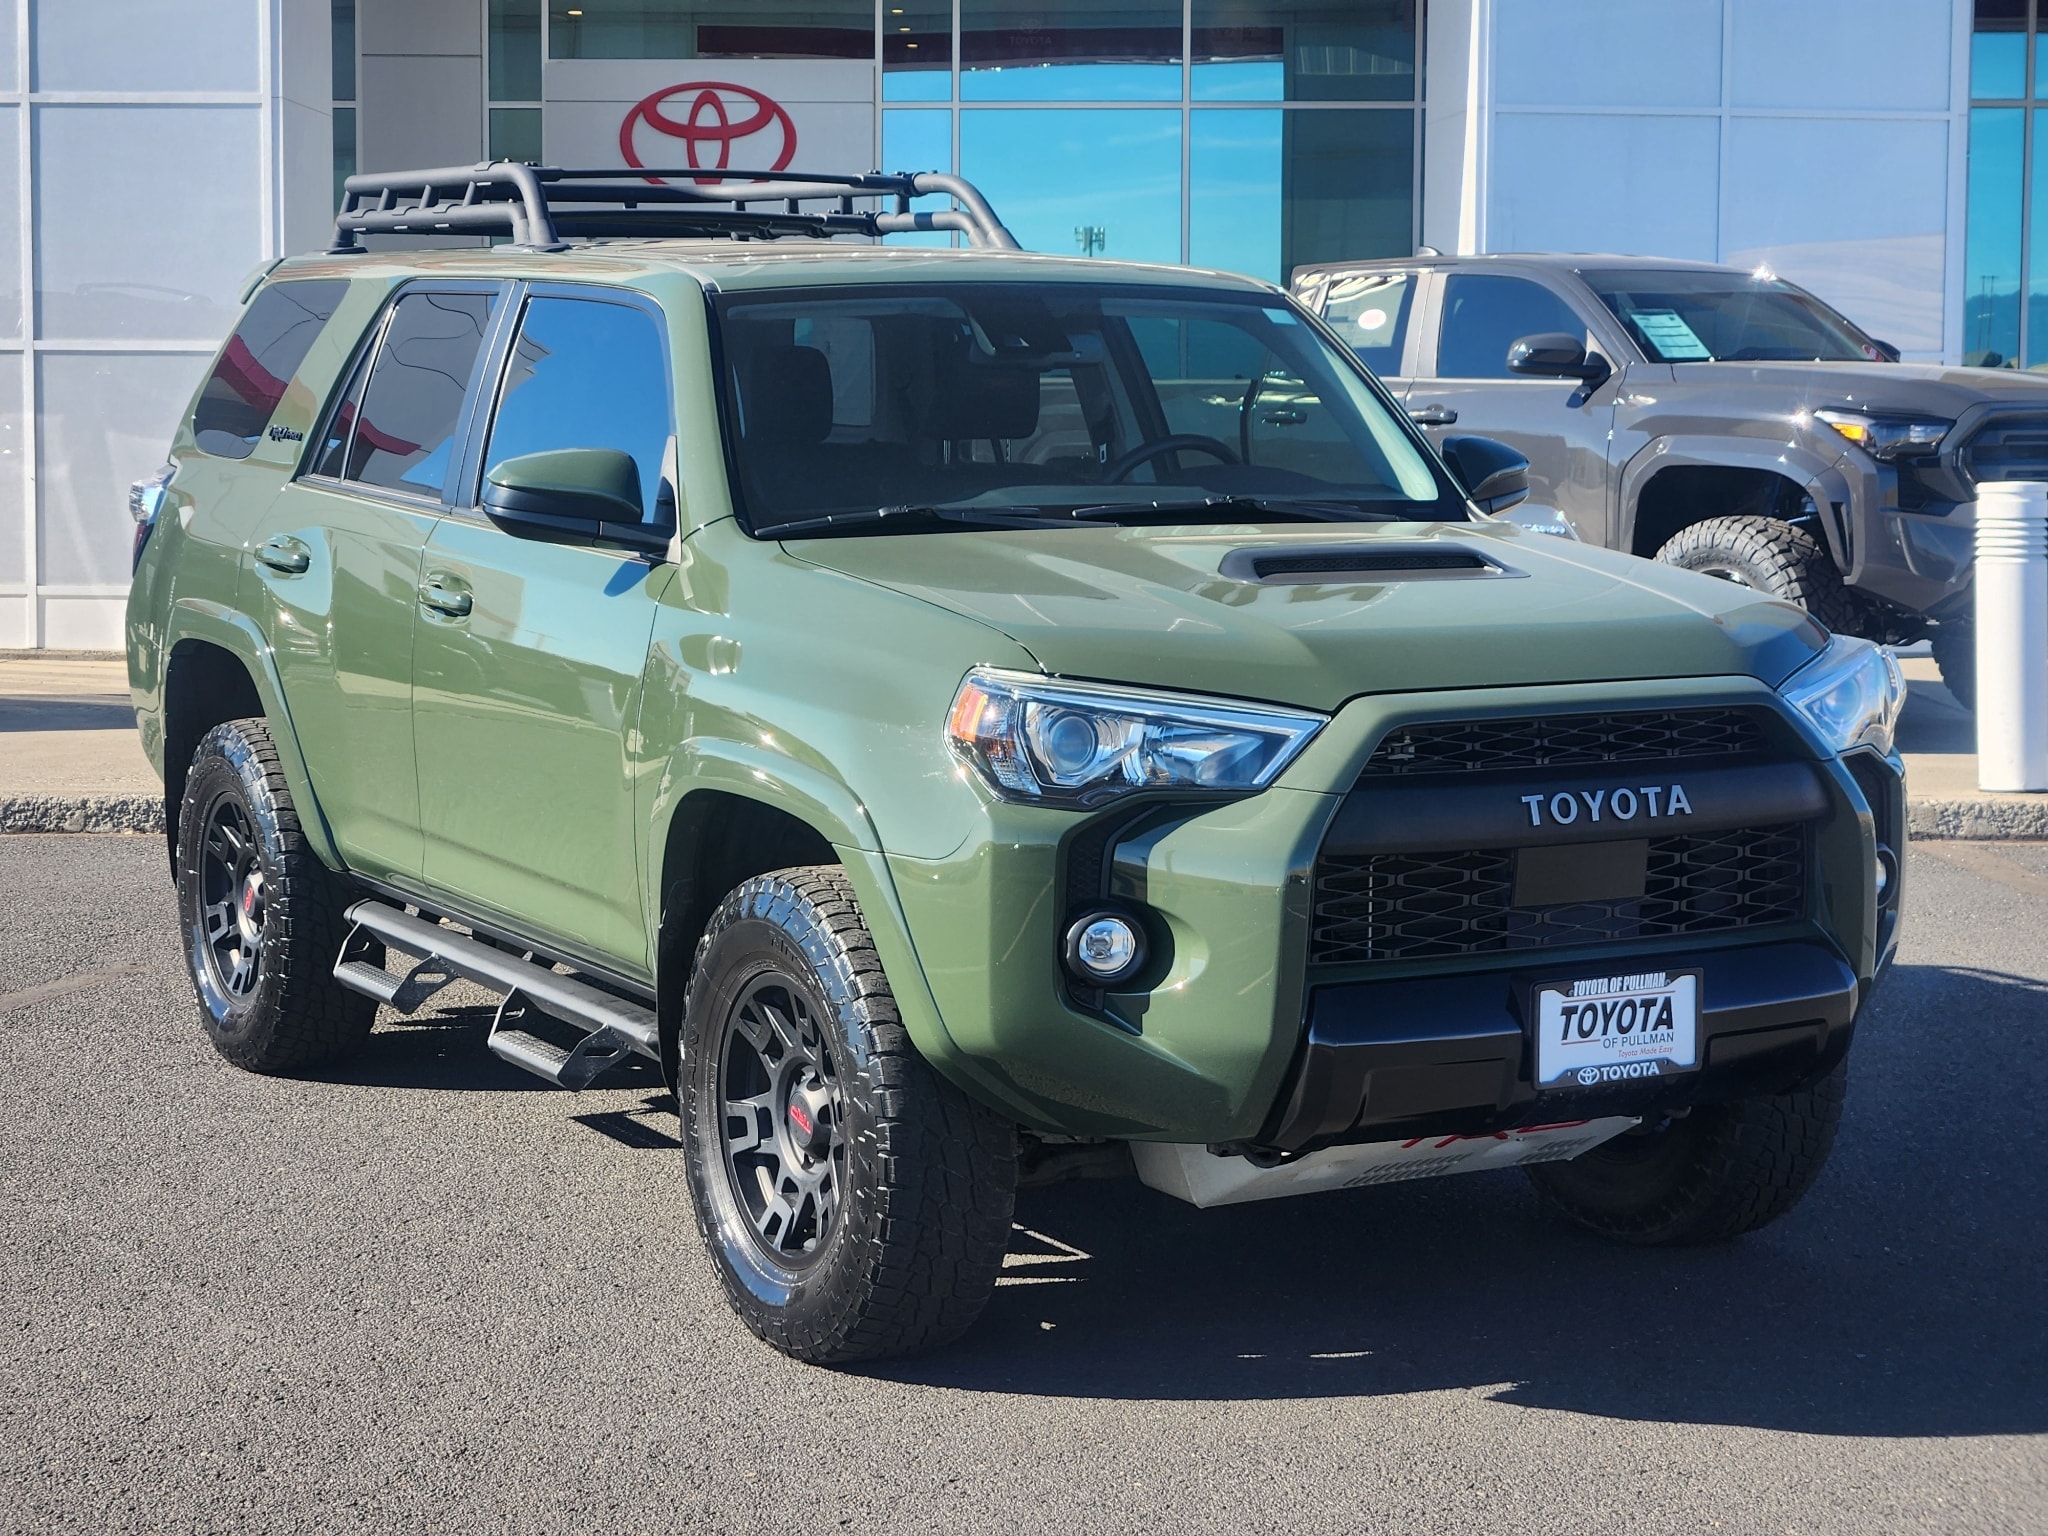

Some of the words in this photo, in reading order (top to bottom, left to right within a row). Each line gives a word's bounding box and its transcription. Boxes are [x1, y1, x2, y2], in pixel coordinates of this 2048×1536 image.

[1521, 784, 1693, 826] TOYOTA
[1573, 979, 1609, 997] TOYOTA
[1609, 977, 1622, 993] OF
[1622, 972, 1667, 991] PULLMAN
[1561, 996, 1674, 1041] TOYOTA
[1603, 1037, 1618, 1049] OF
[1622, 1032, 1674, 1047] PULLMAN
[1618, 1049, 1639, 1059] Toyota
[1640, 1047, 1658, 1056] Made
[1659, 1046, 1673, 1055] Easy
[1600, 1061, 1660, 1082] TOYOTA
